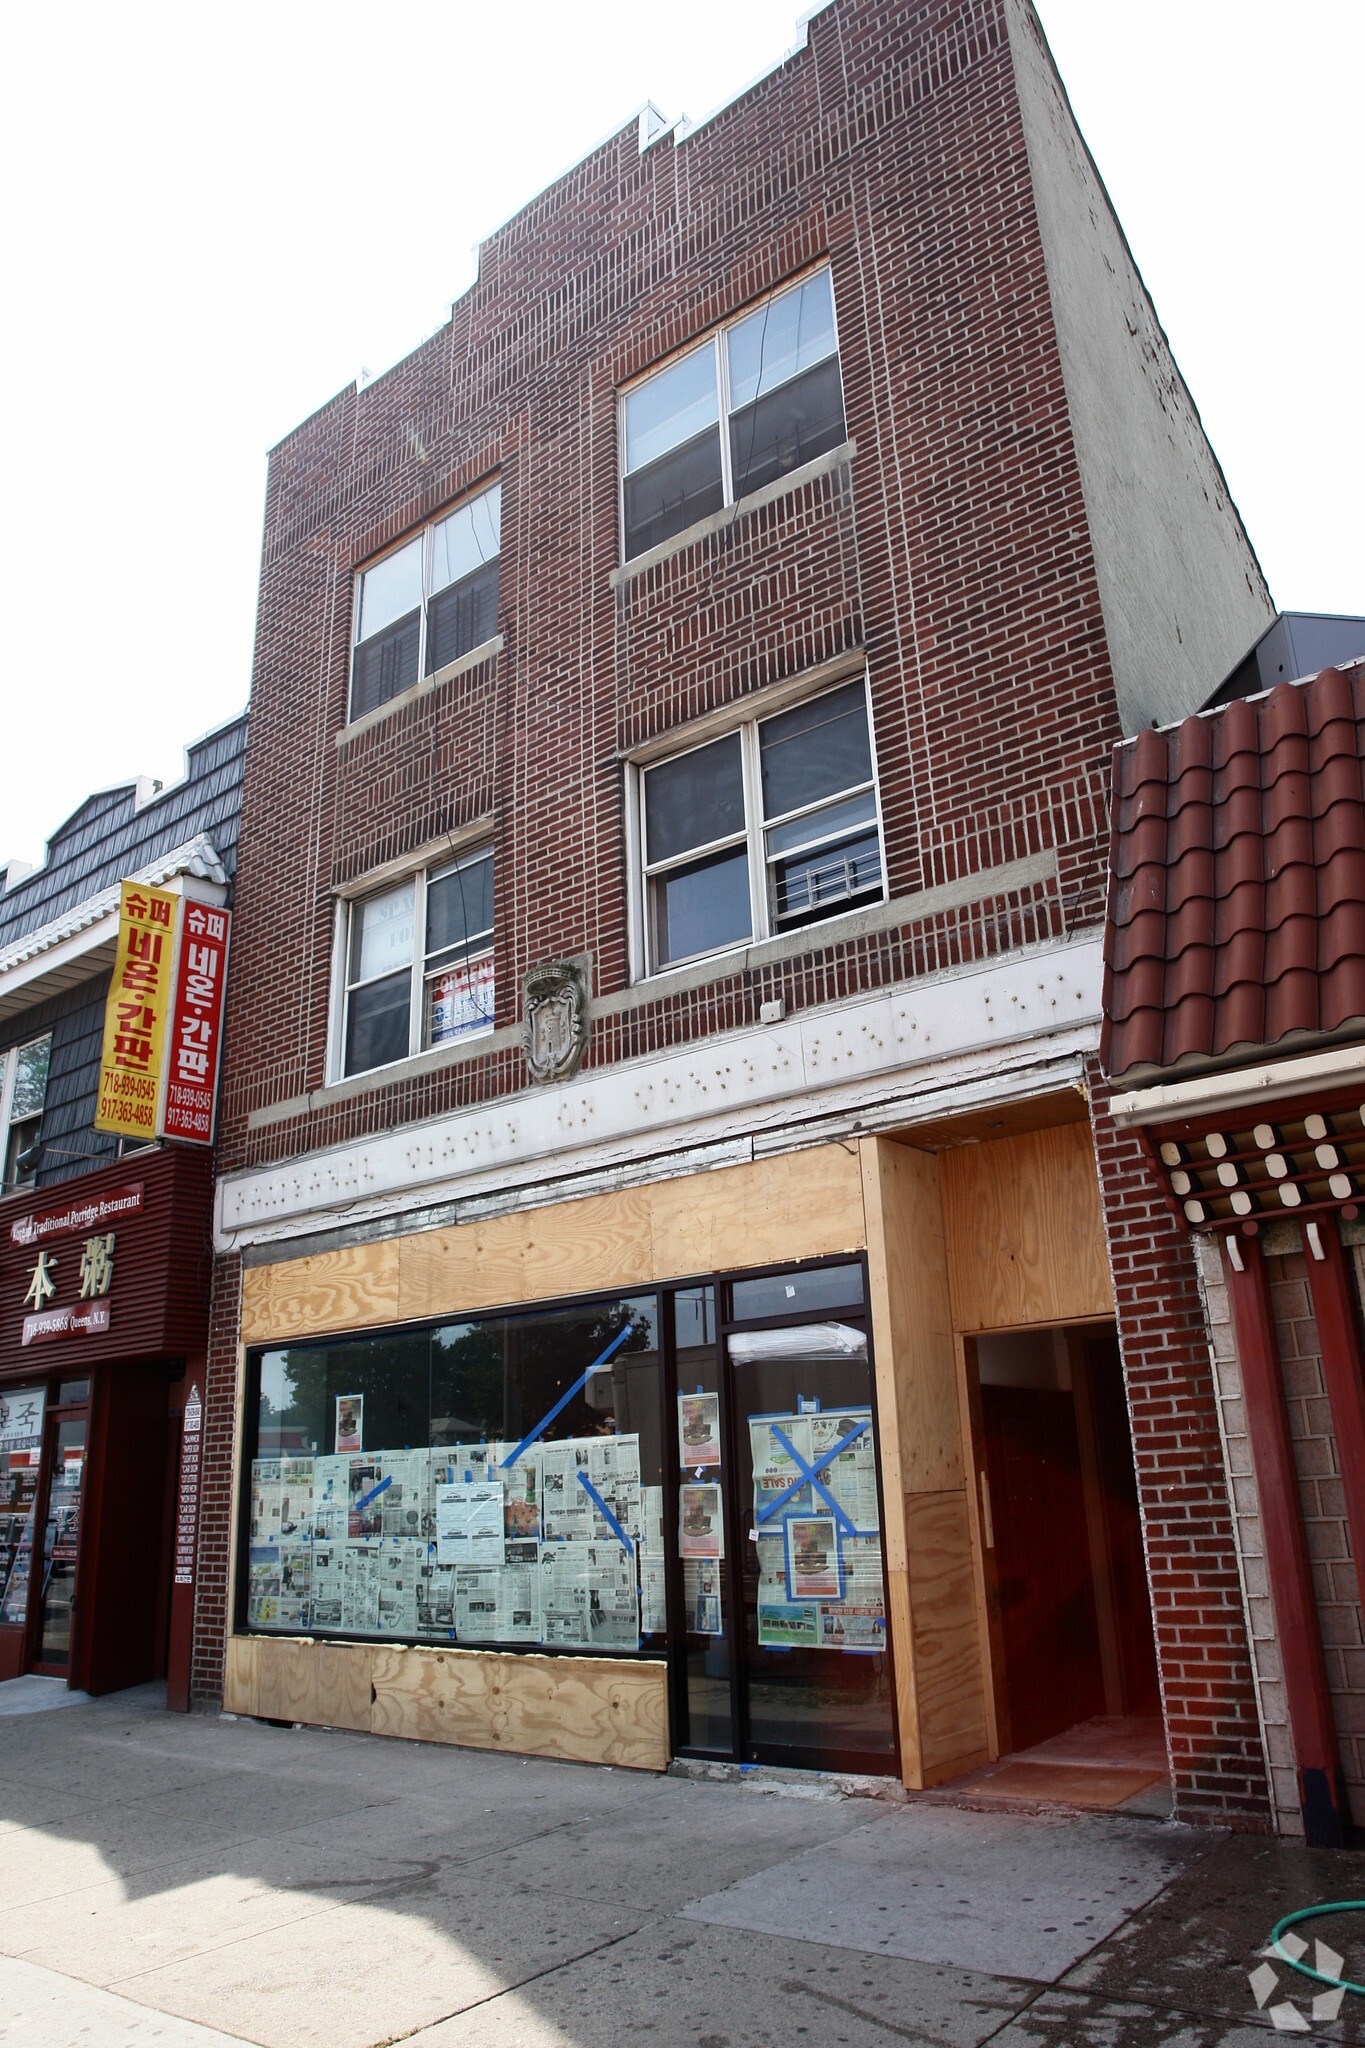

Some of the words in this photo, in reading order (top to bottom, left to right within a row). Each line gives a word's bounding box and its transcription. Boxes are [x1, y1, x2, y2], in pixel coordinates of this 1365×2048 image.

[125, 894, 171, 927] 슈퍼
[188, 909, 225, 942] 슈퍼
[104, 1072, 156, 1100] 718-939-0545
[169, 1084, 211, 1110] 718-939-0545
[101, 1098, 153, 1127] 917-363-4858
[167, 1109, 209, 1133] 917-363-4858
[33, 1211, 70, 1235] Traditional
[70, 1204, 98, 1225] Porridge
[99, 1193, 141, 1214] Restaurant
